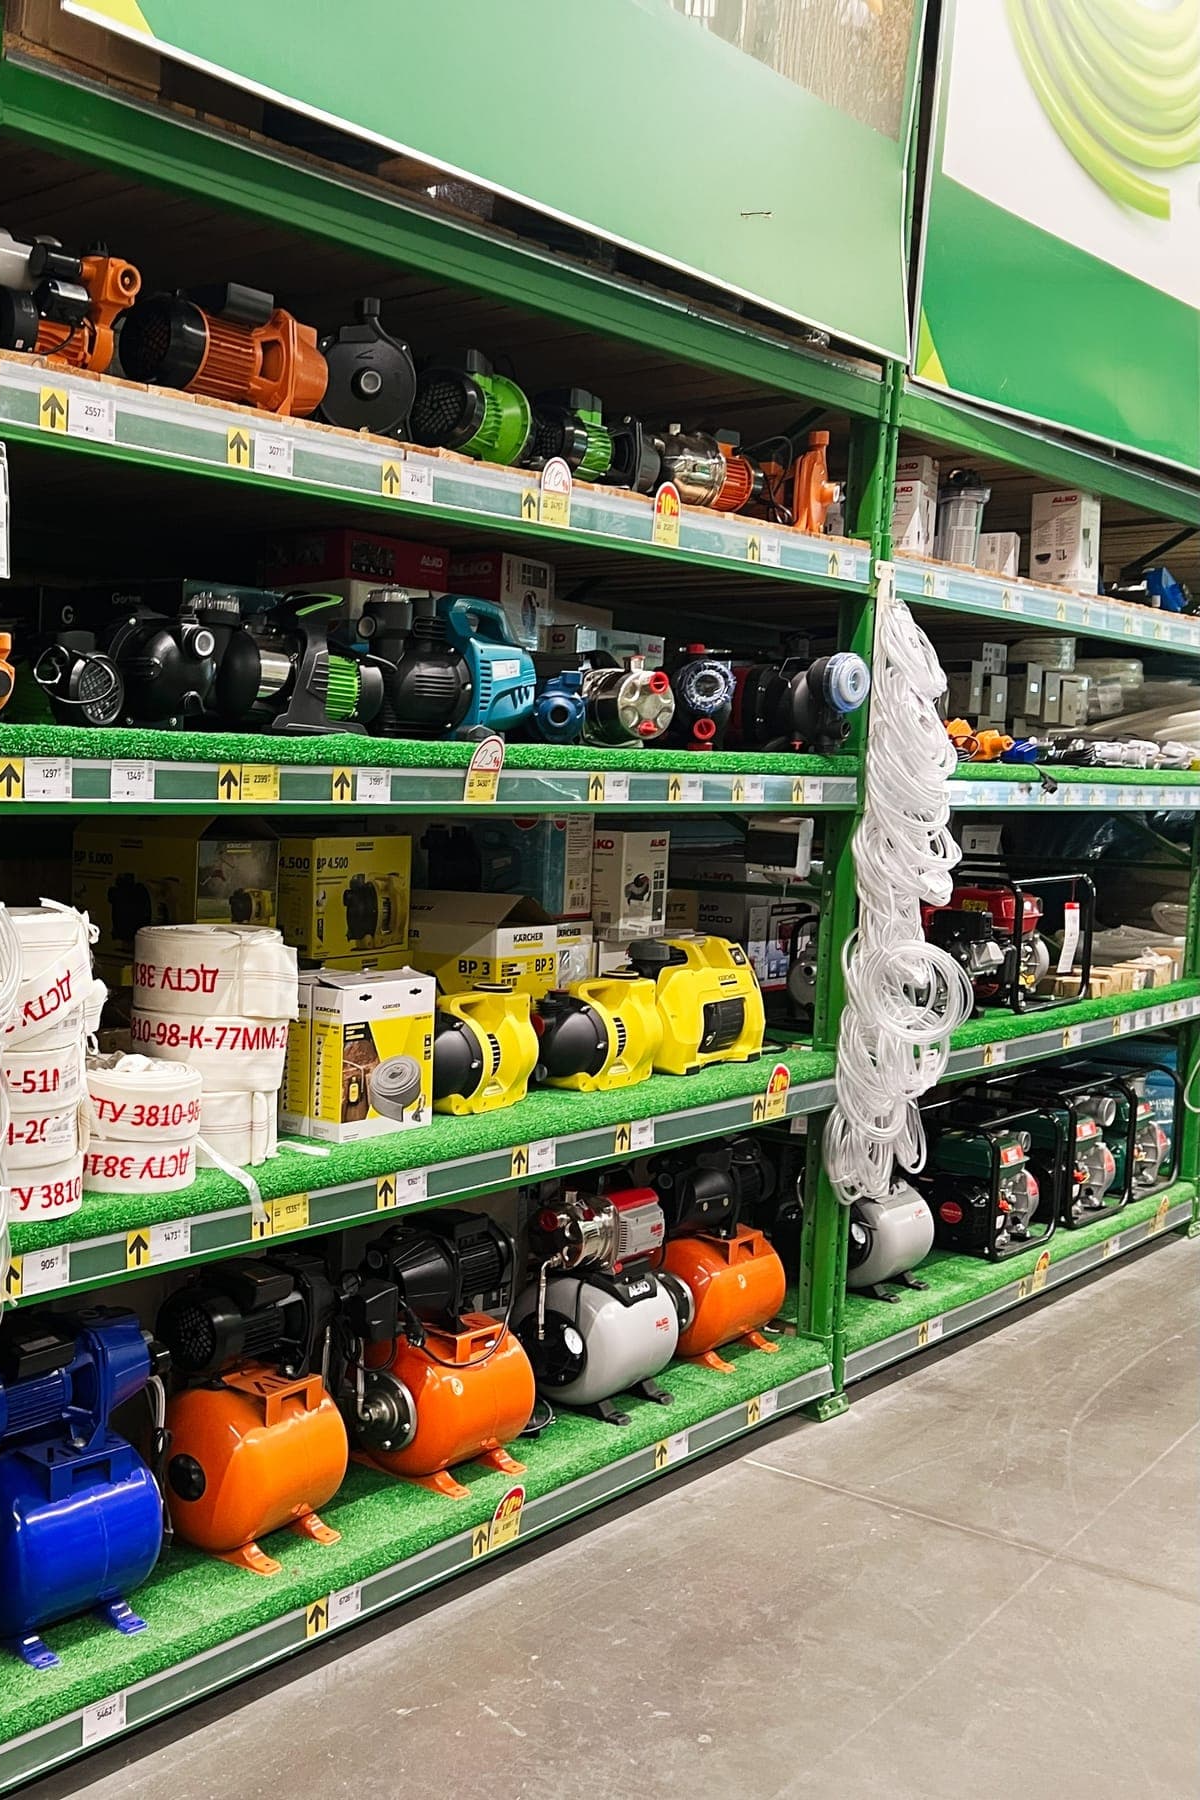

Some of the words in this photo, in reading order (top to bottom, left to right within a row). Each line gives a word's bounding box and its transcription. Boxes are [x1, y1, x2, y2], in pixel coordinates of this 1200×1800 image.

[458, 959, 477, 974] BP
[482, 960, 490, 975] 3
[535, 958, 546, 972] BP
[548, 957, 554, 971] 3
[161, 963, 219, 992] ДСТУ
[139, 1146, 190, 1179] ДСТУ
[41, 1258, 55, 1270] 905
